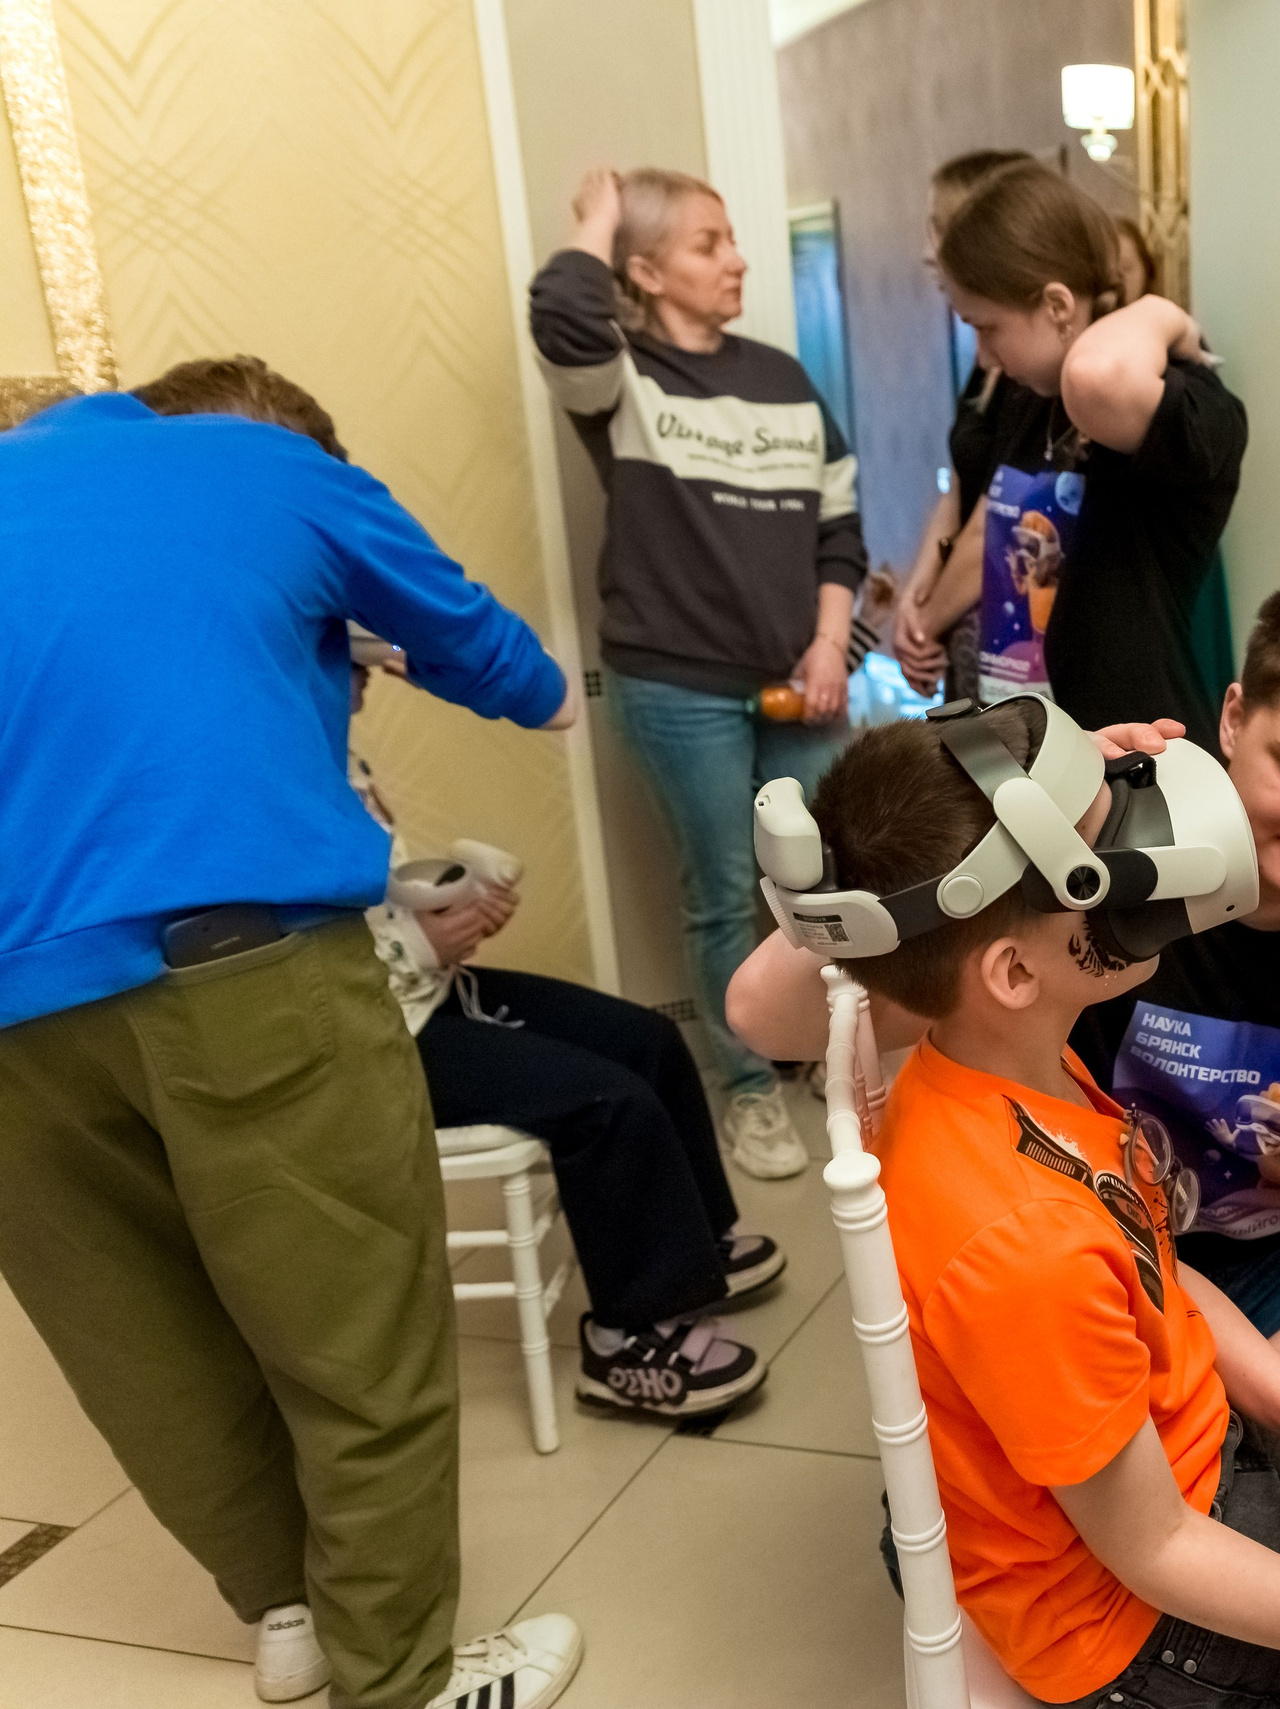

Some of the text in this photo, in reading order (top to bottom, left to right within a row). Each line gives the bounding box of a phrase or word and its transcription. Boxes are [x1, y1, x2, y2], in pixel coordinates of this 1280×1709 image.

[1141, 1012, 1192, 1037] НАУКА
[1135, 1031, 1202, 1059] БРЯНСК
[1130, 1045, 1261, 1085] ВОЛОНТЕРСТВО
